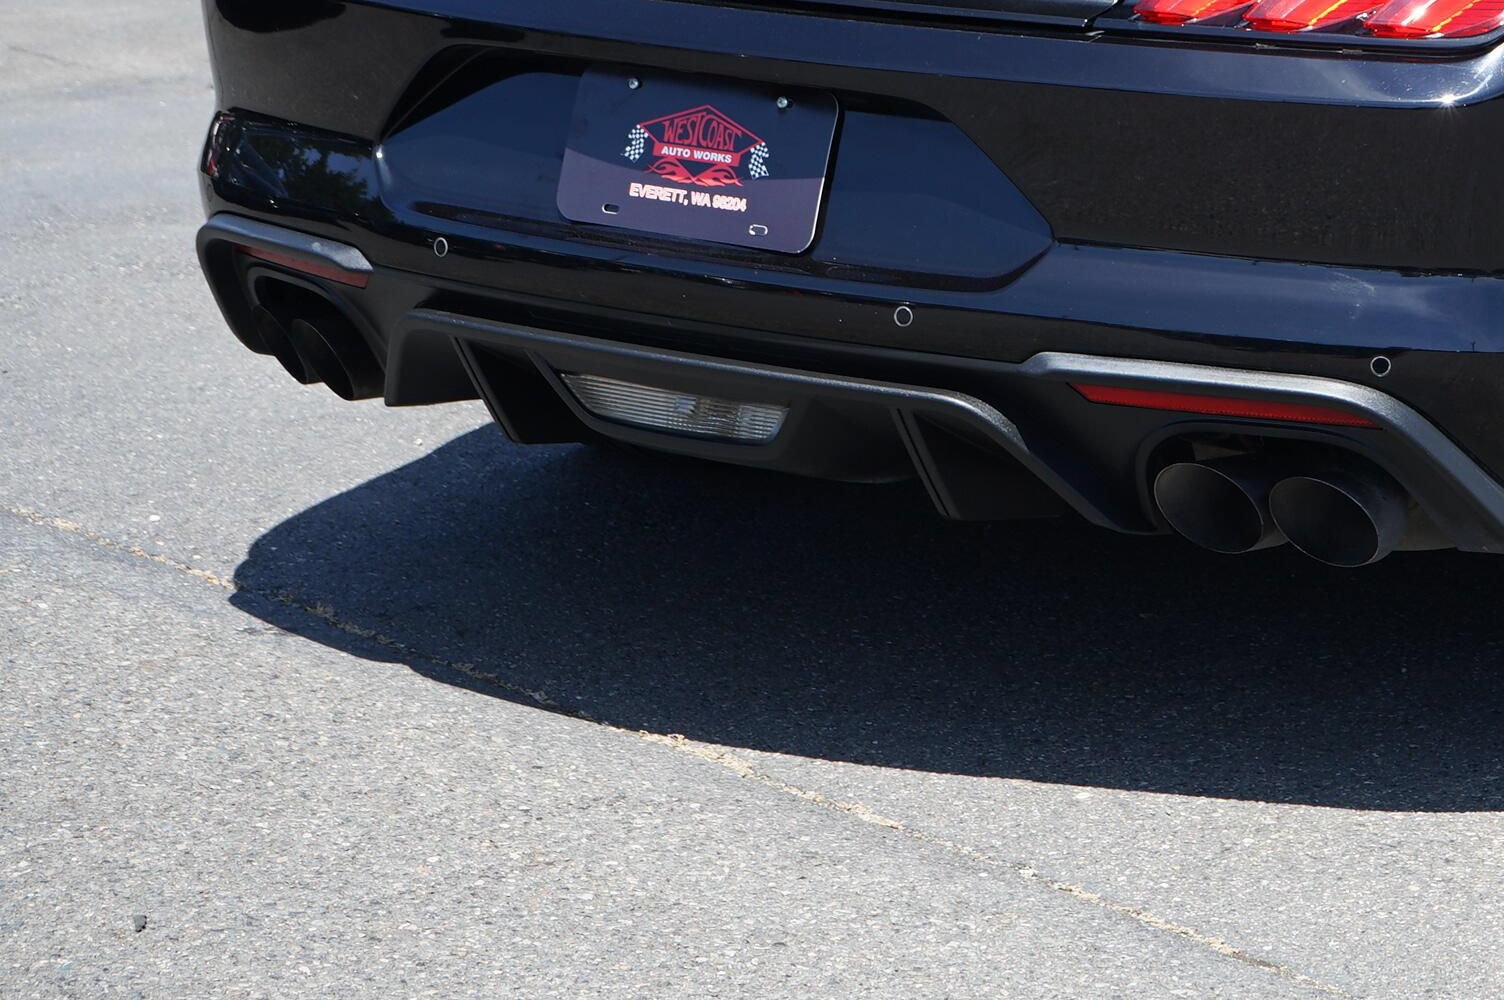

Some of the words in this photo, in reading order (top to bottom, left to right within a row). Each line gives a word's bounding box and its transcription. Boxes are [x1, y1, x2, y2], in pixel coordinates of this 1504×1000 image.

[661, 145, 691, 158] AUTO
[693, 150, 733, 164] WORKS
[629, 182, 689, 206] EVERETT,
[691, 191, 711, 208] WA
